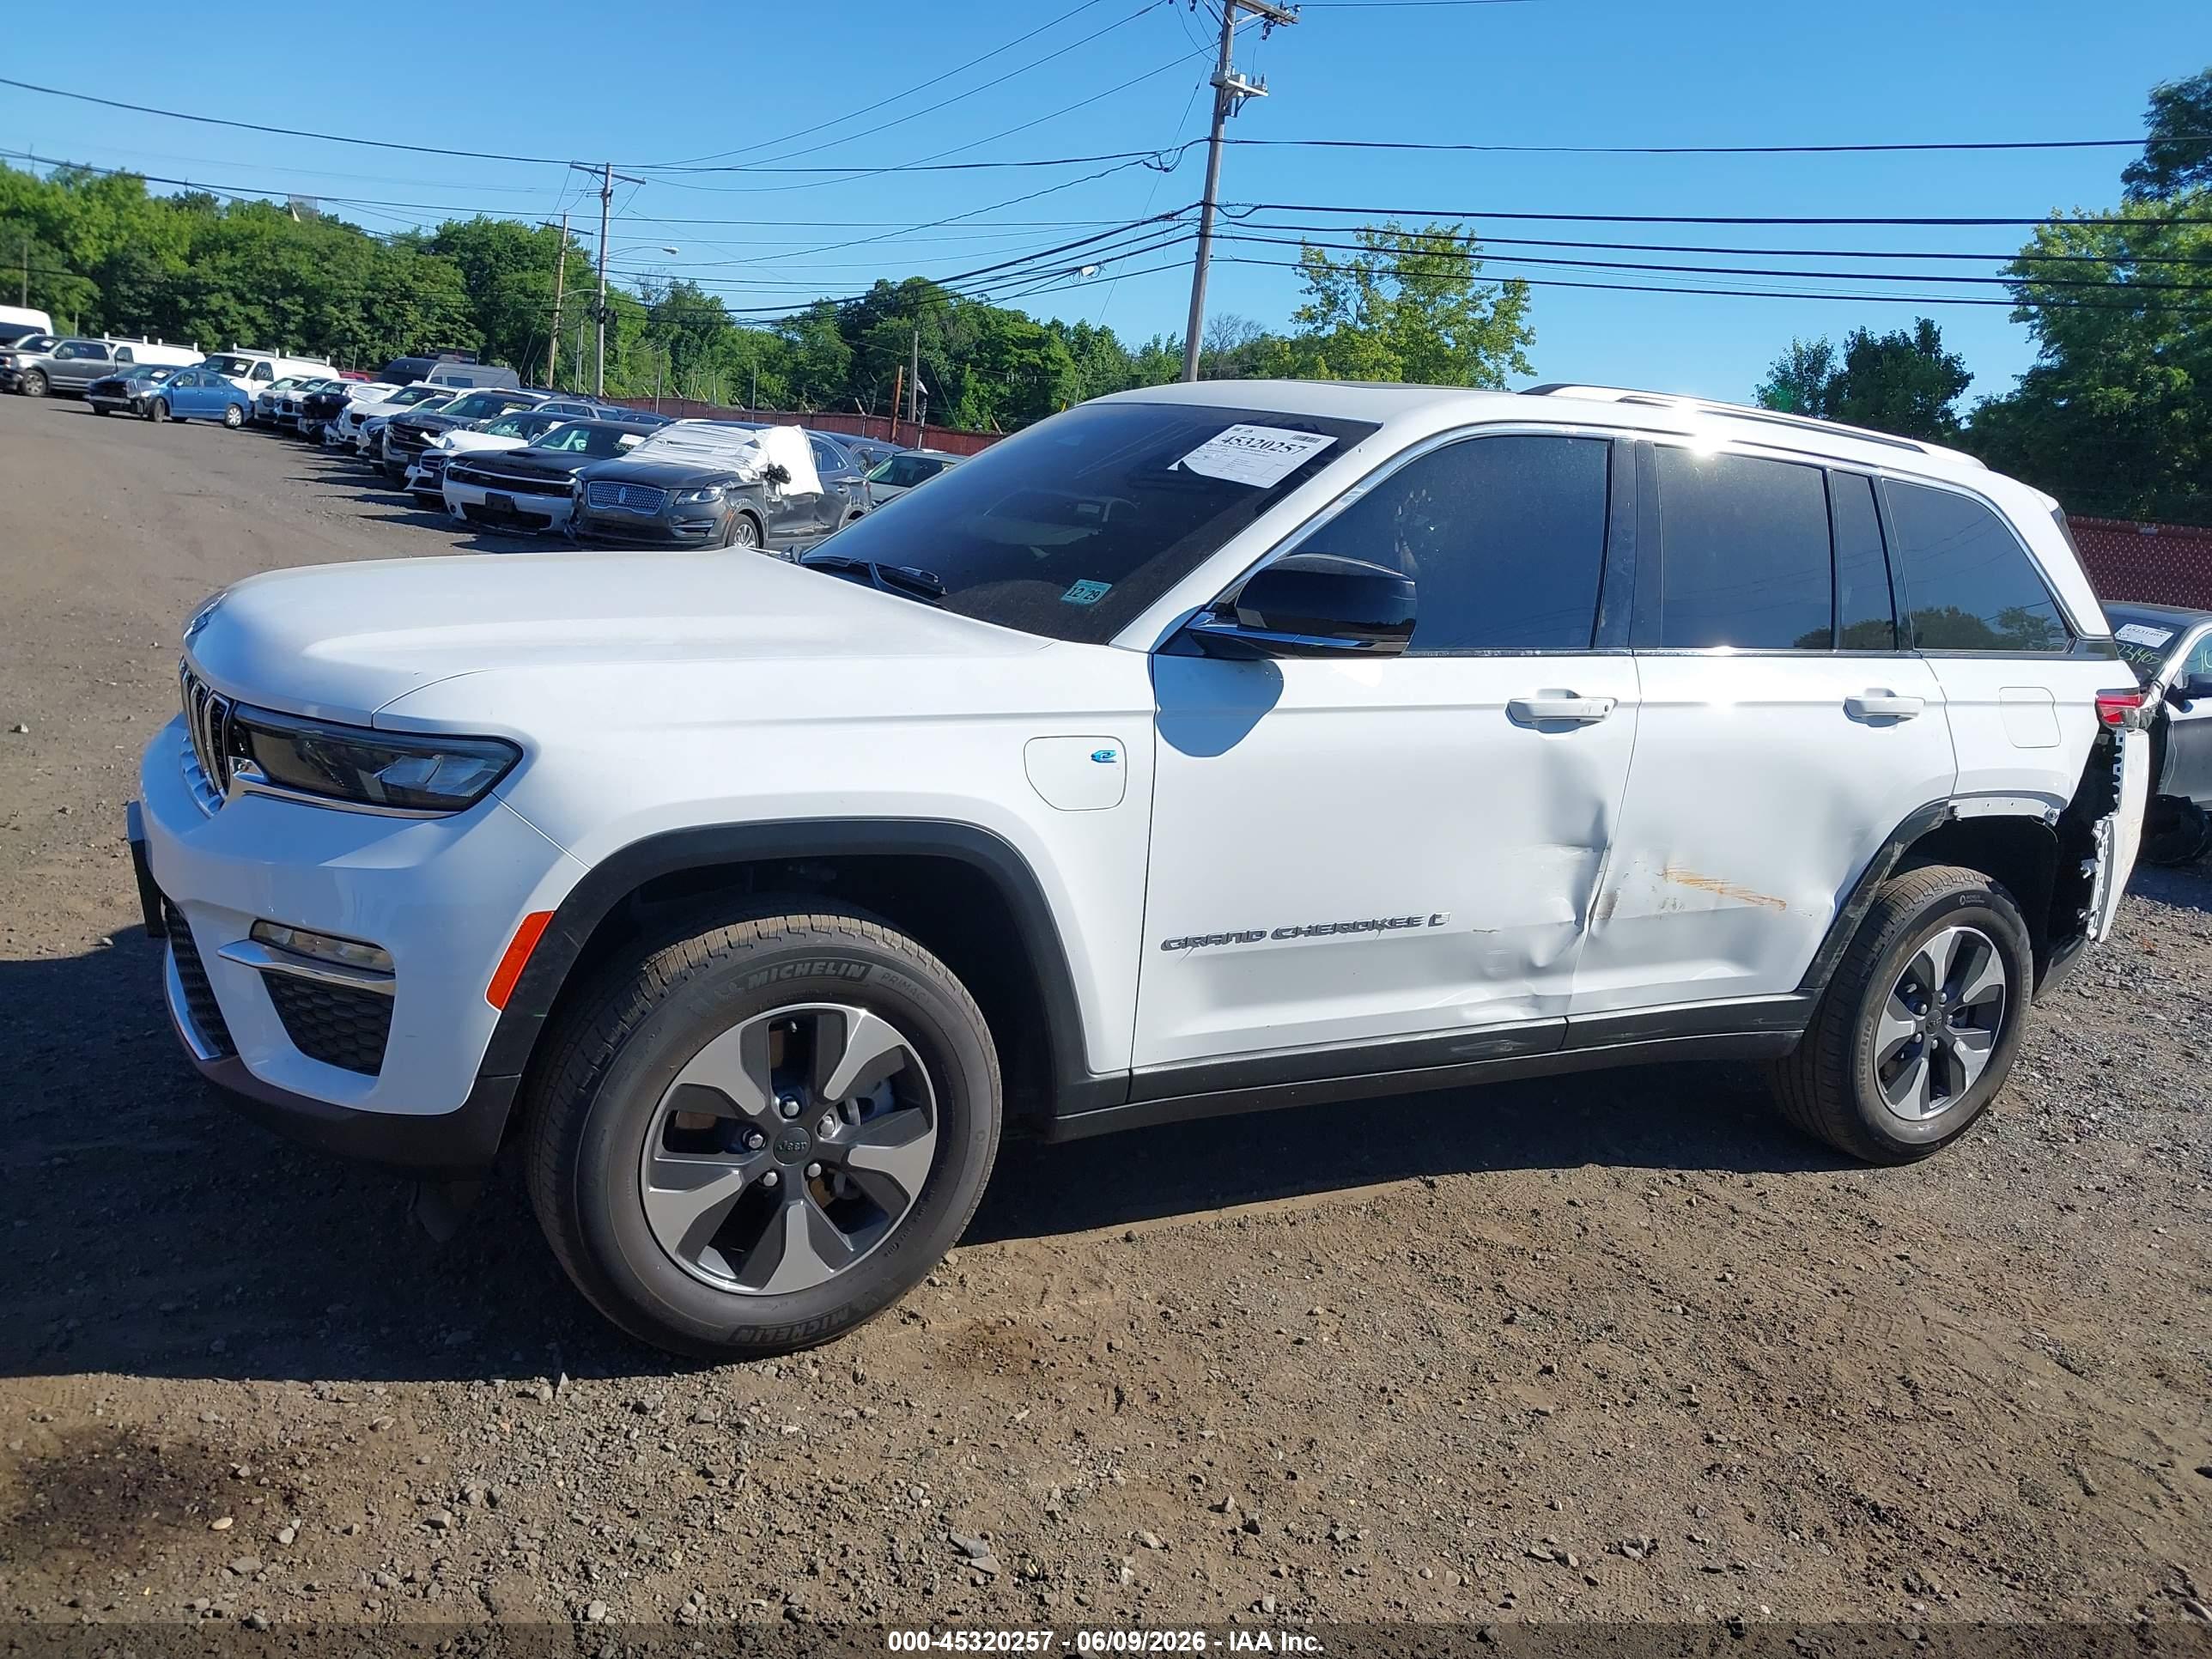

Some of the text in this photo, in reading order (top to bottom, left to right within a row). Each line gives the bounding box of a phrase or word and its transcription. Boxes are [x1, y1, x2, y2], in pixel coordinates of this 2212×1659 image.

[1221, 435, 1310, 455] 45320257
[1067, 586, 1101, 601] 12 29
[1161, 915, 1426, 951] GRAND CHEROKEE
[748, 961, 866, 988] MICHELIN
[734, 1307, 849, 1343] MICHELIN
